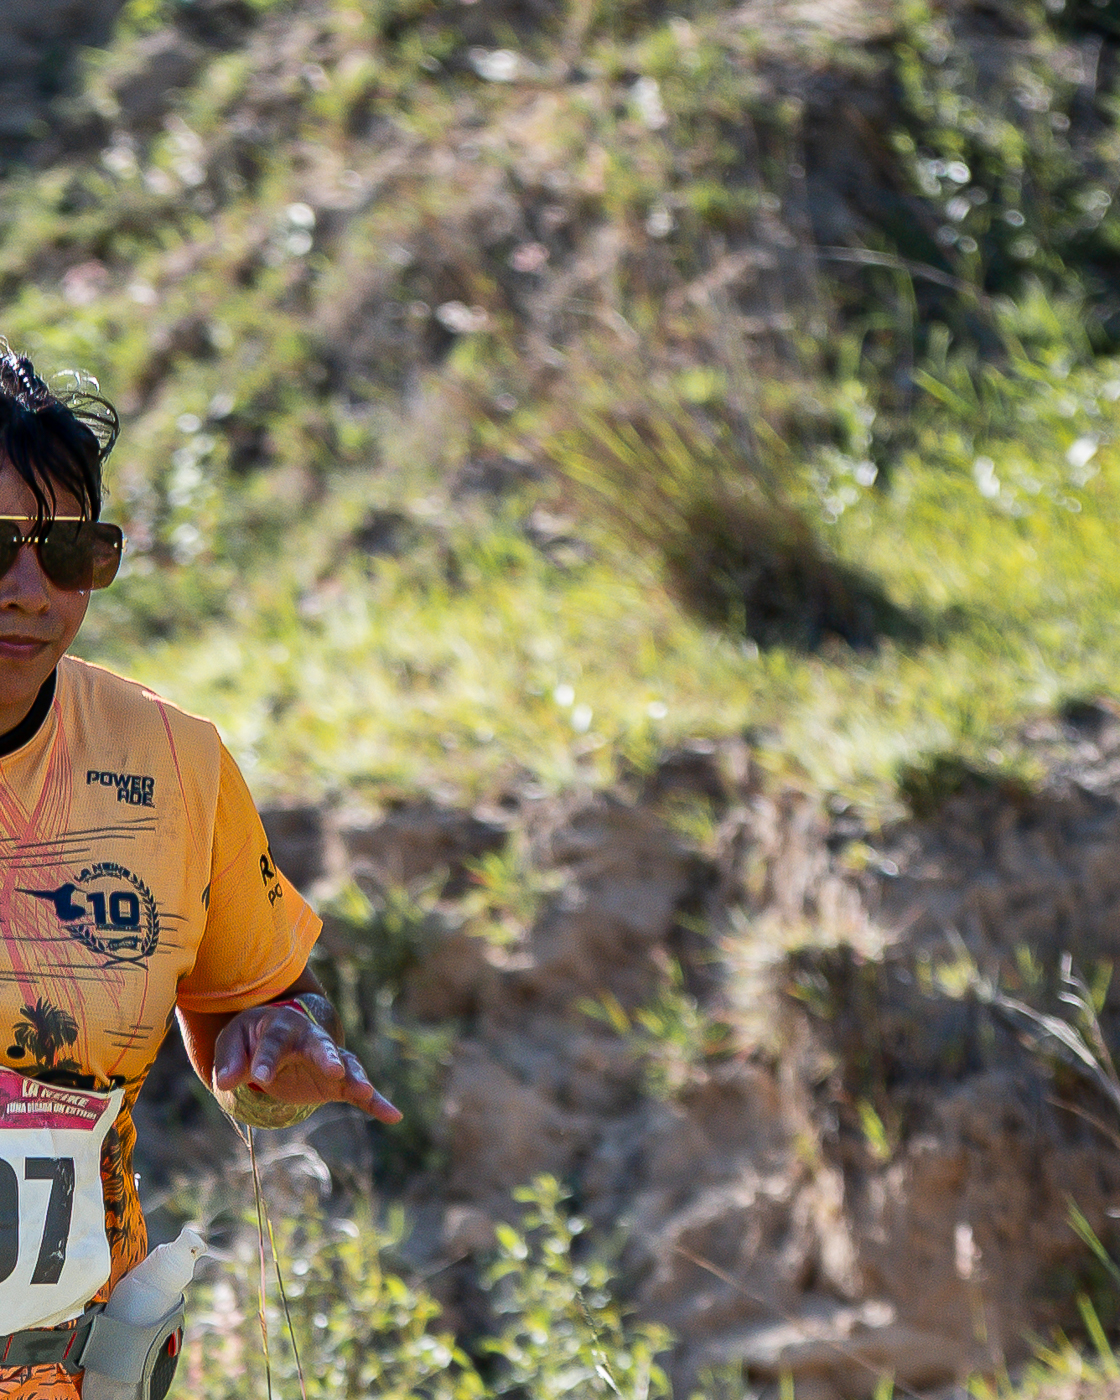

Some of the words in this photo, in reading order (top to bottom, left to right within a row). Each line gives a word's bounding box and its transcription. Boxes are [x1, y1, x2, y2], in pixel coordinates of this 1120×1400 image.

[86, 770, 155, 792] POWER
[117, 788, 156, 808] ADE
[86, 891, 140, 926] 10
